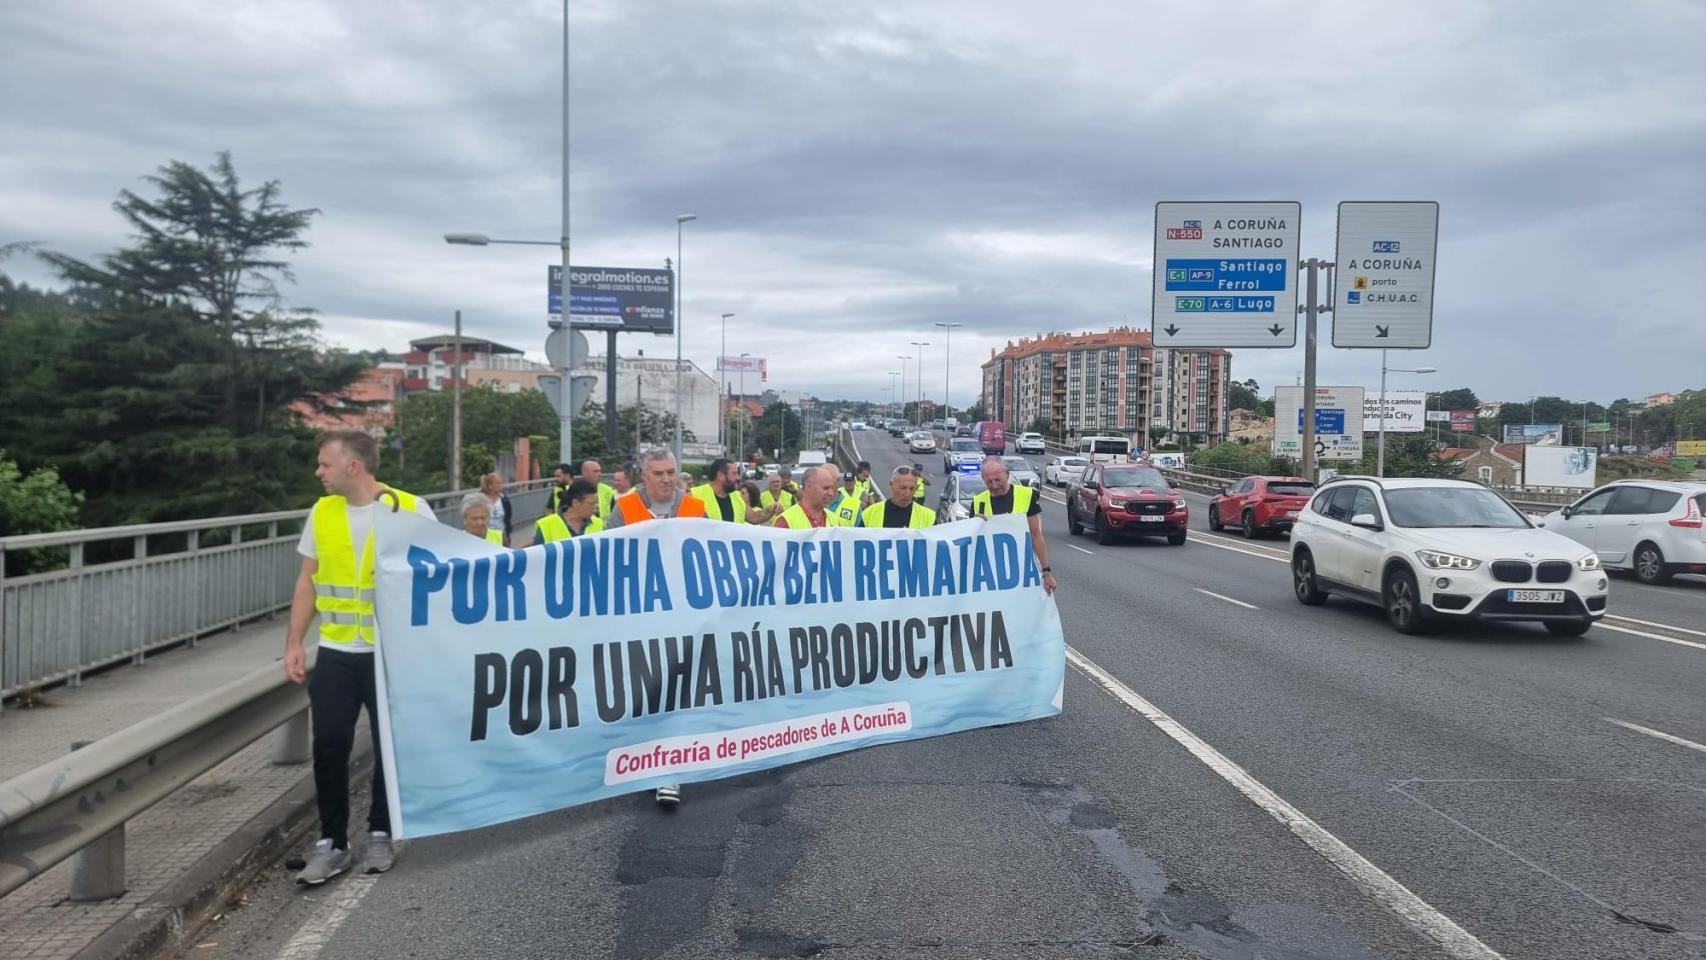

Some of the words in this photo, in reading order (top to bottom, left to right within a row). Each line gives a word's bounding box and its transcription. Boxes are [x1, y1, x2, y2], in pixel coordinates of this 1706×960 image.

[1213, 220, 1222, 230] A
[1227, 217, 1287, 230] CORUÑA
[1168, 229, 1201, 239] N-550
[1213, 238, 1283, 248] SANTIAGO
[1373, 243, 1400, 251] AC-12
[1220, 261, 1282, 274] Santiago
[1349, 260, 1358, 270] A
[1363, 258, 1422, 270] CORUÑA
[553, 268, 669, 285] inegralmotion.es
[1170, 271, 1185, 279] E-1
[1191, 271, 1212, 279] AP-9
[1219, 280, 1259, 290] Ferrol
[1372, 278, 1397, 286] porto
[1367, 294, 1421, 303] C.H.U.A.C.
[1178, 301, 1202, 309] E-70
[1211, 300, 1232, 309] A-6
[1238, 299, 1272, 310] Lugo
[1395, 411, 1412, 421] City
[406, 543, 528, 626] POR
[544, 538, 673, 620] UNHA
[681, 538, 776, 611] OBRA
[784, 541, 843, 606] BEN
[854, 531, 1041, 602] REMATADA
[1516, 591, 1541, 601] 3505
[470, 646, 579, 742] POR
[593, 633, 723, 723] UNHA
[731, 621, 786, 704] RÍA
[789, 610, 1014, 694] PRODUCTIVA
[615, 741, 710, 775] Confraría
[717, 737, 737, 759] de
[741, 723, 818, 760] pescadores
[821, 718, 837, 738] de
[840, 716, 851, 733] A
[853, 708, 907, 732] Coruña
